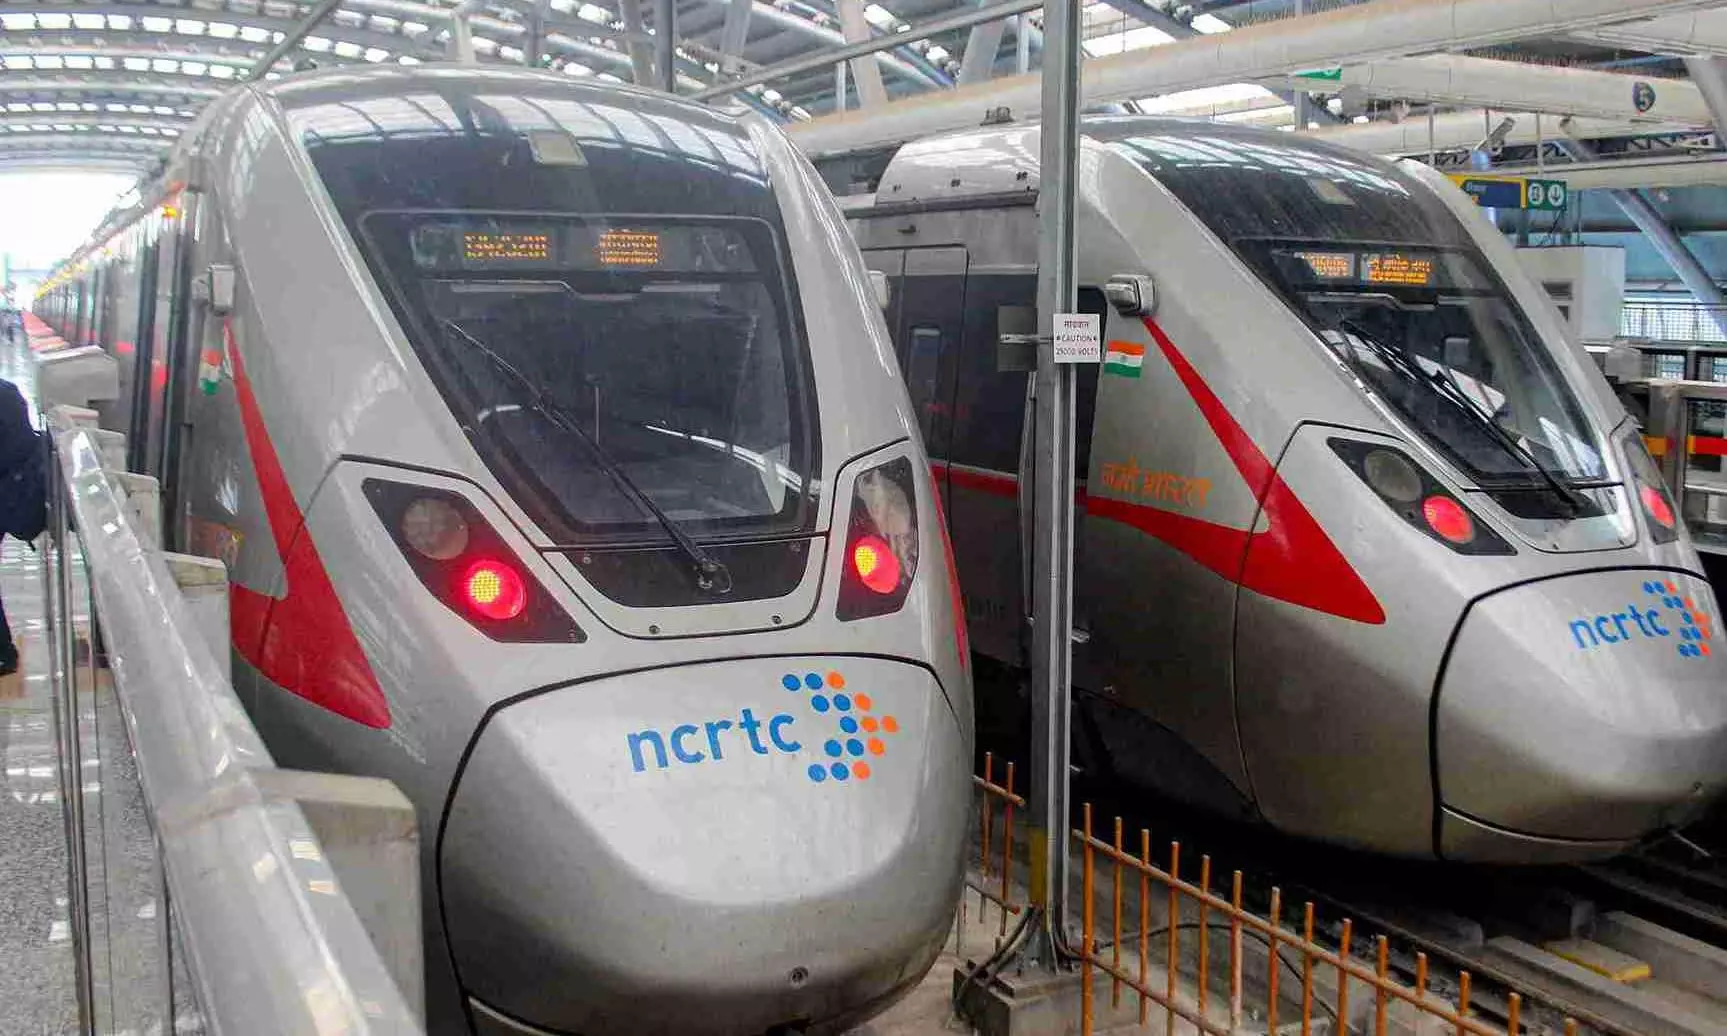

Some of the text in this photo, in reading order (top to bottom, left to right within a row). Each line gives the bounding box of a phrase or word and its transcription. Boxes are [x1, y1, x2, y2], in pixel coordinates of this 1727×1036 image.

[1062, 334, 1092, 342] CAUTION
[1568, 603, 1670, 649] ncrtc
[626, 707, 802, 773] ncrtc
